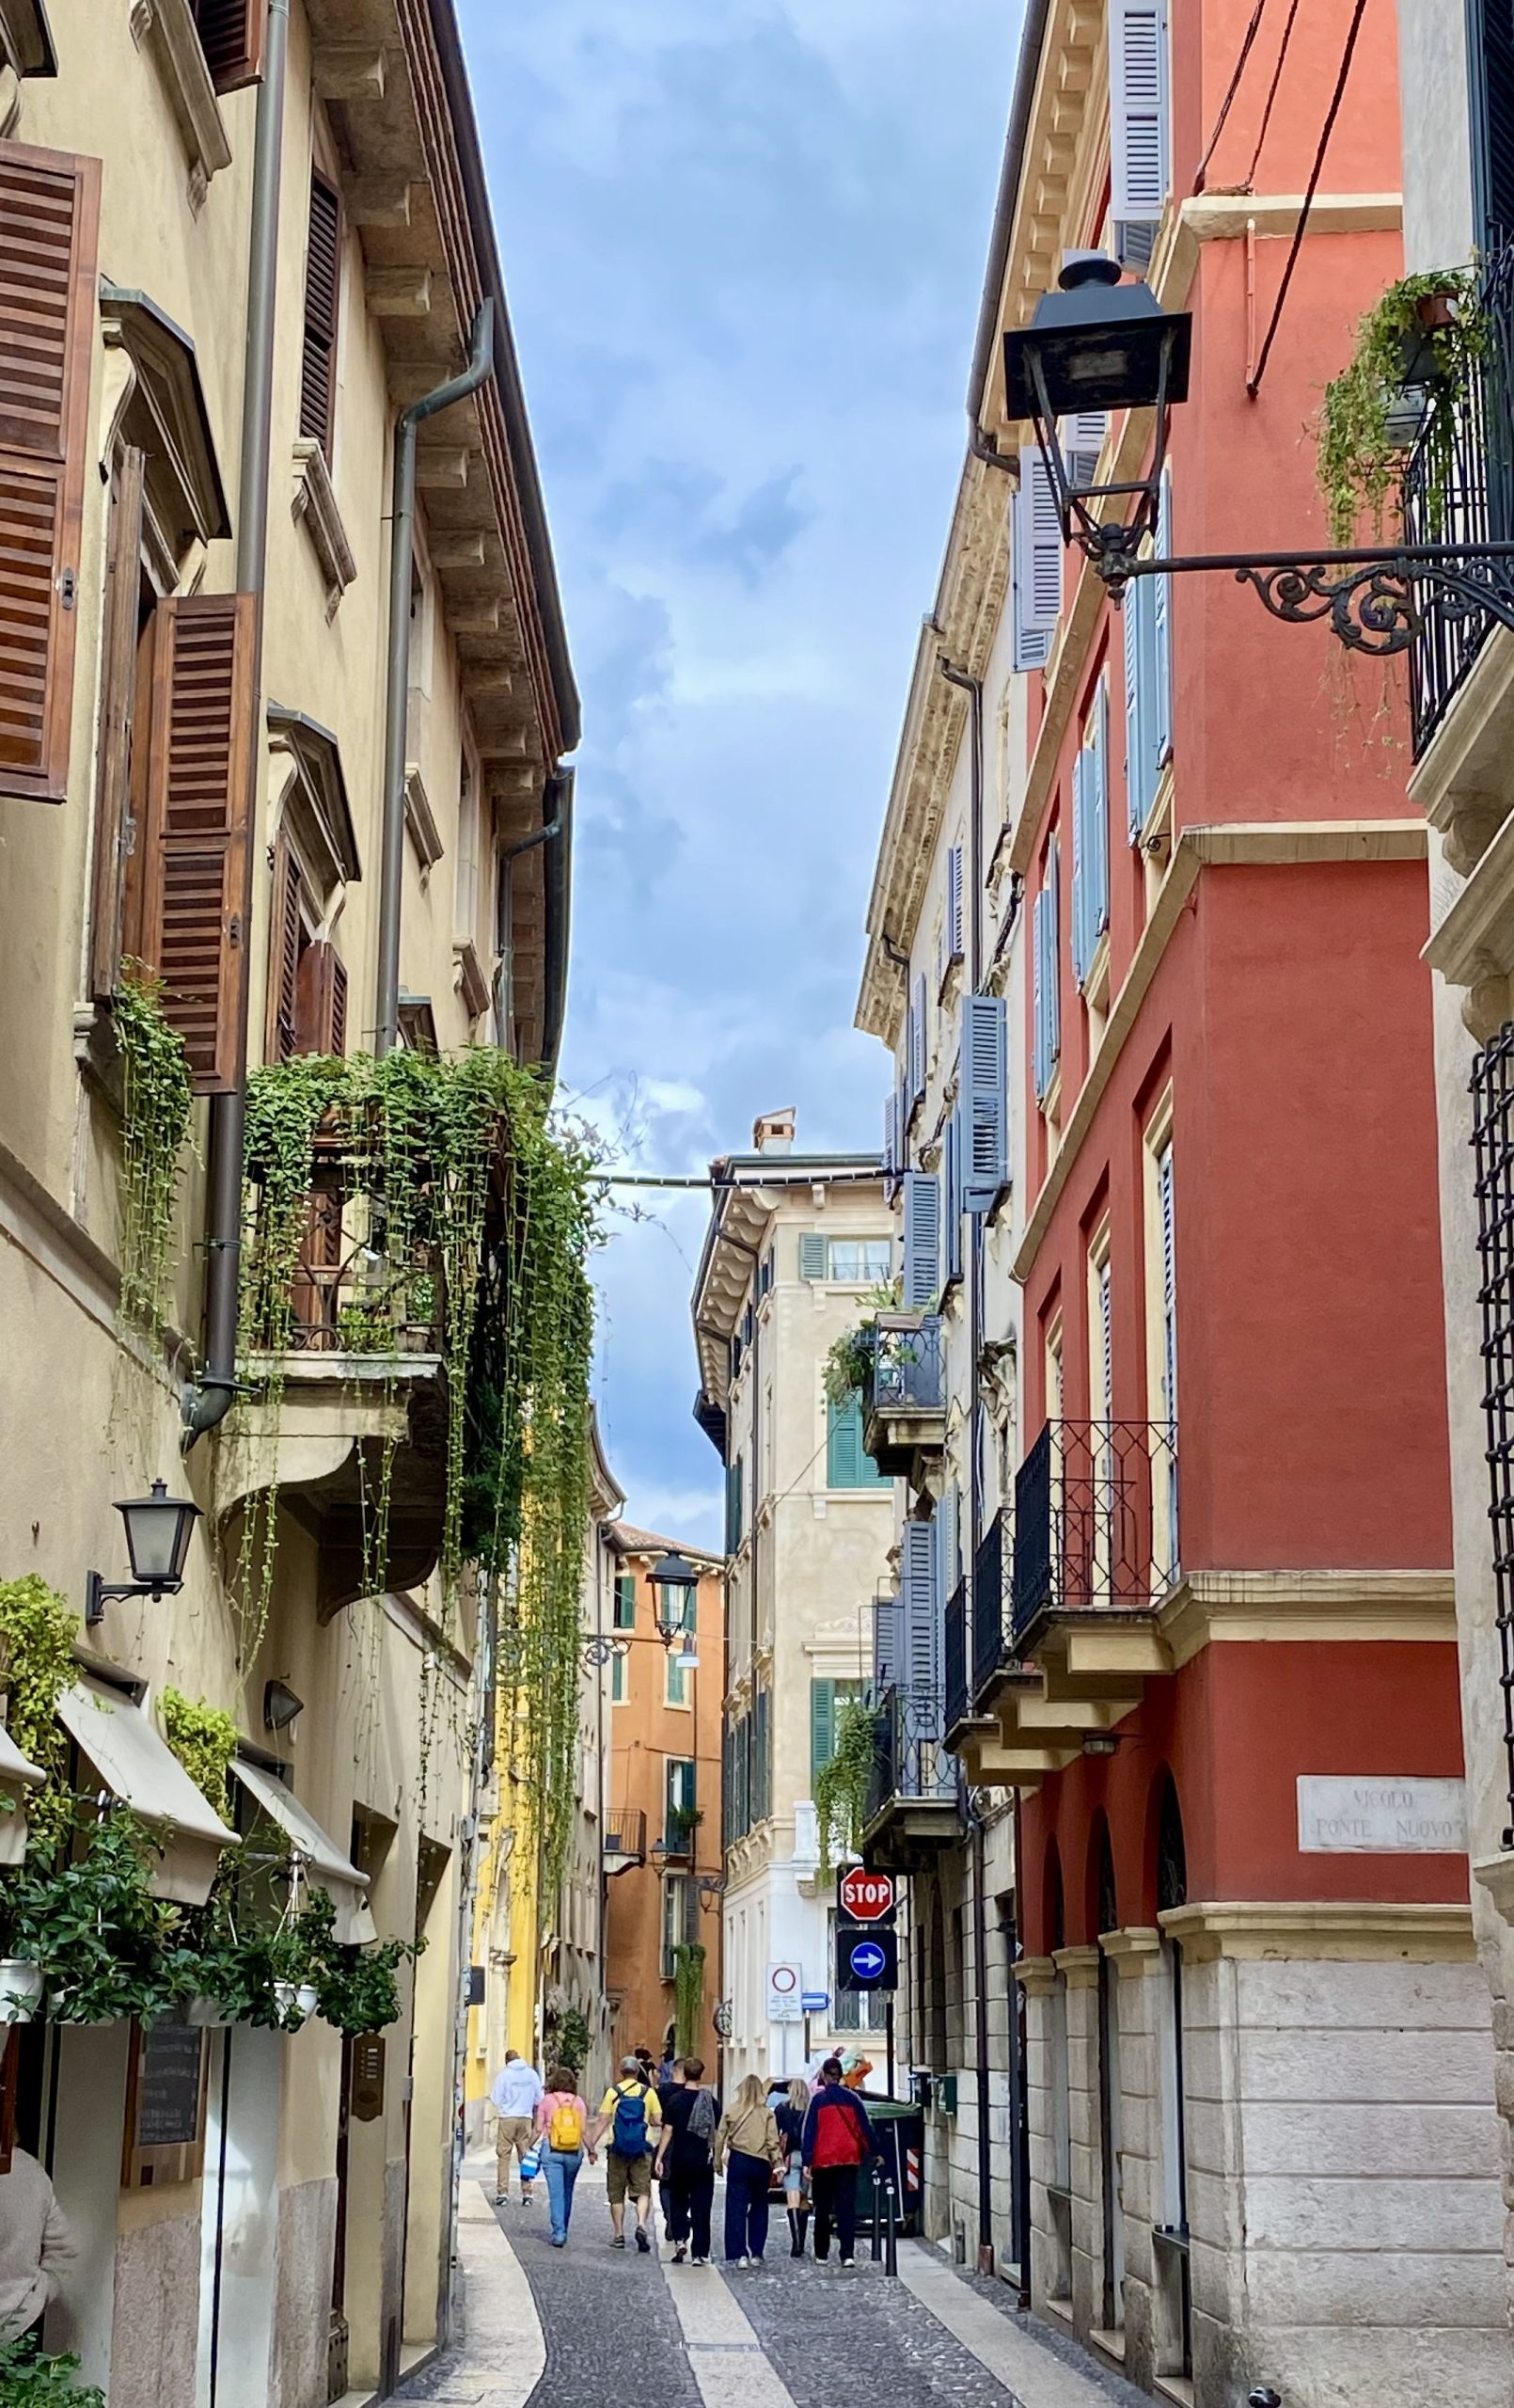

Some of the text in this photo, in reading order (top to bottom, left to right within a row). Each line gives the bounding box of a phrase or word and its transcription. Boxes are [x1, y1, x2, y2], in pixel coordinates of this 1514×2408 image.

[1353, 1790, 1413, 1809] VICOLO
[1317, 1818, 1453, 1838] PONTE NUOVO
[845, 1883, 890, 1904] STOP
